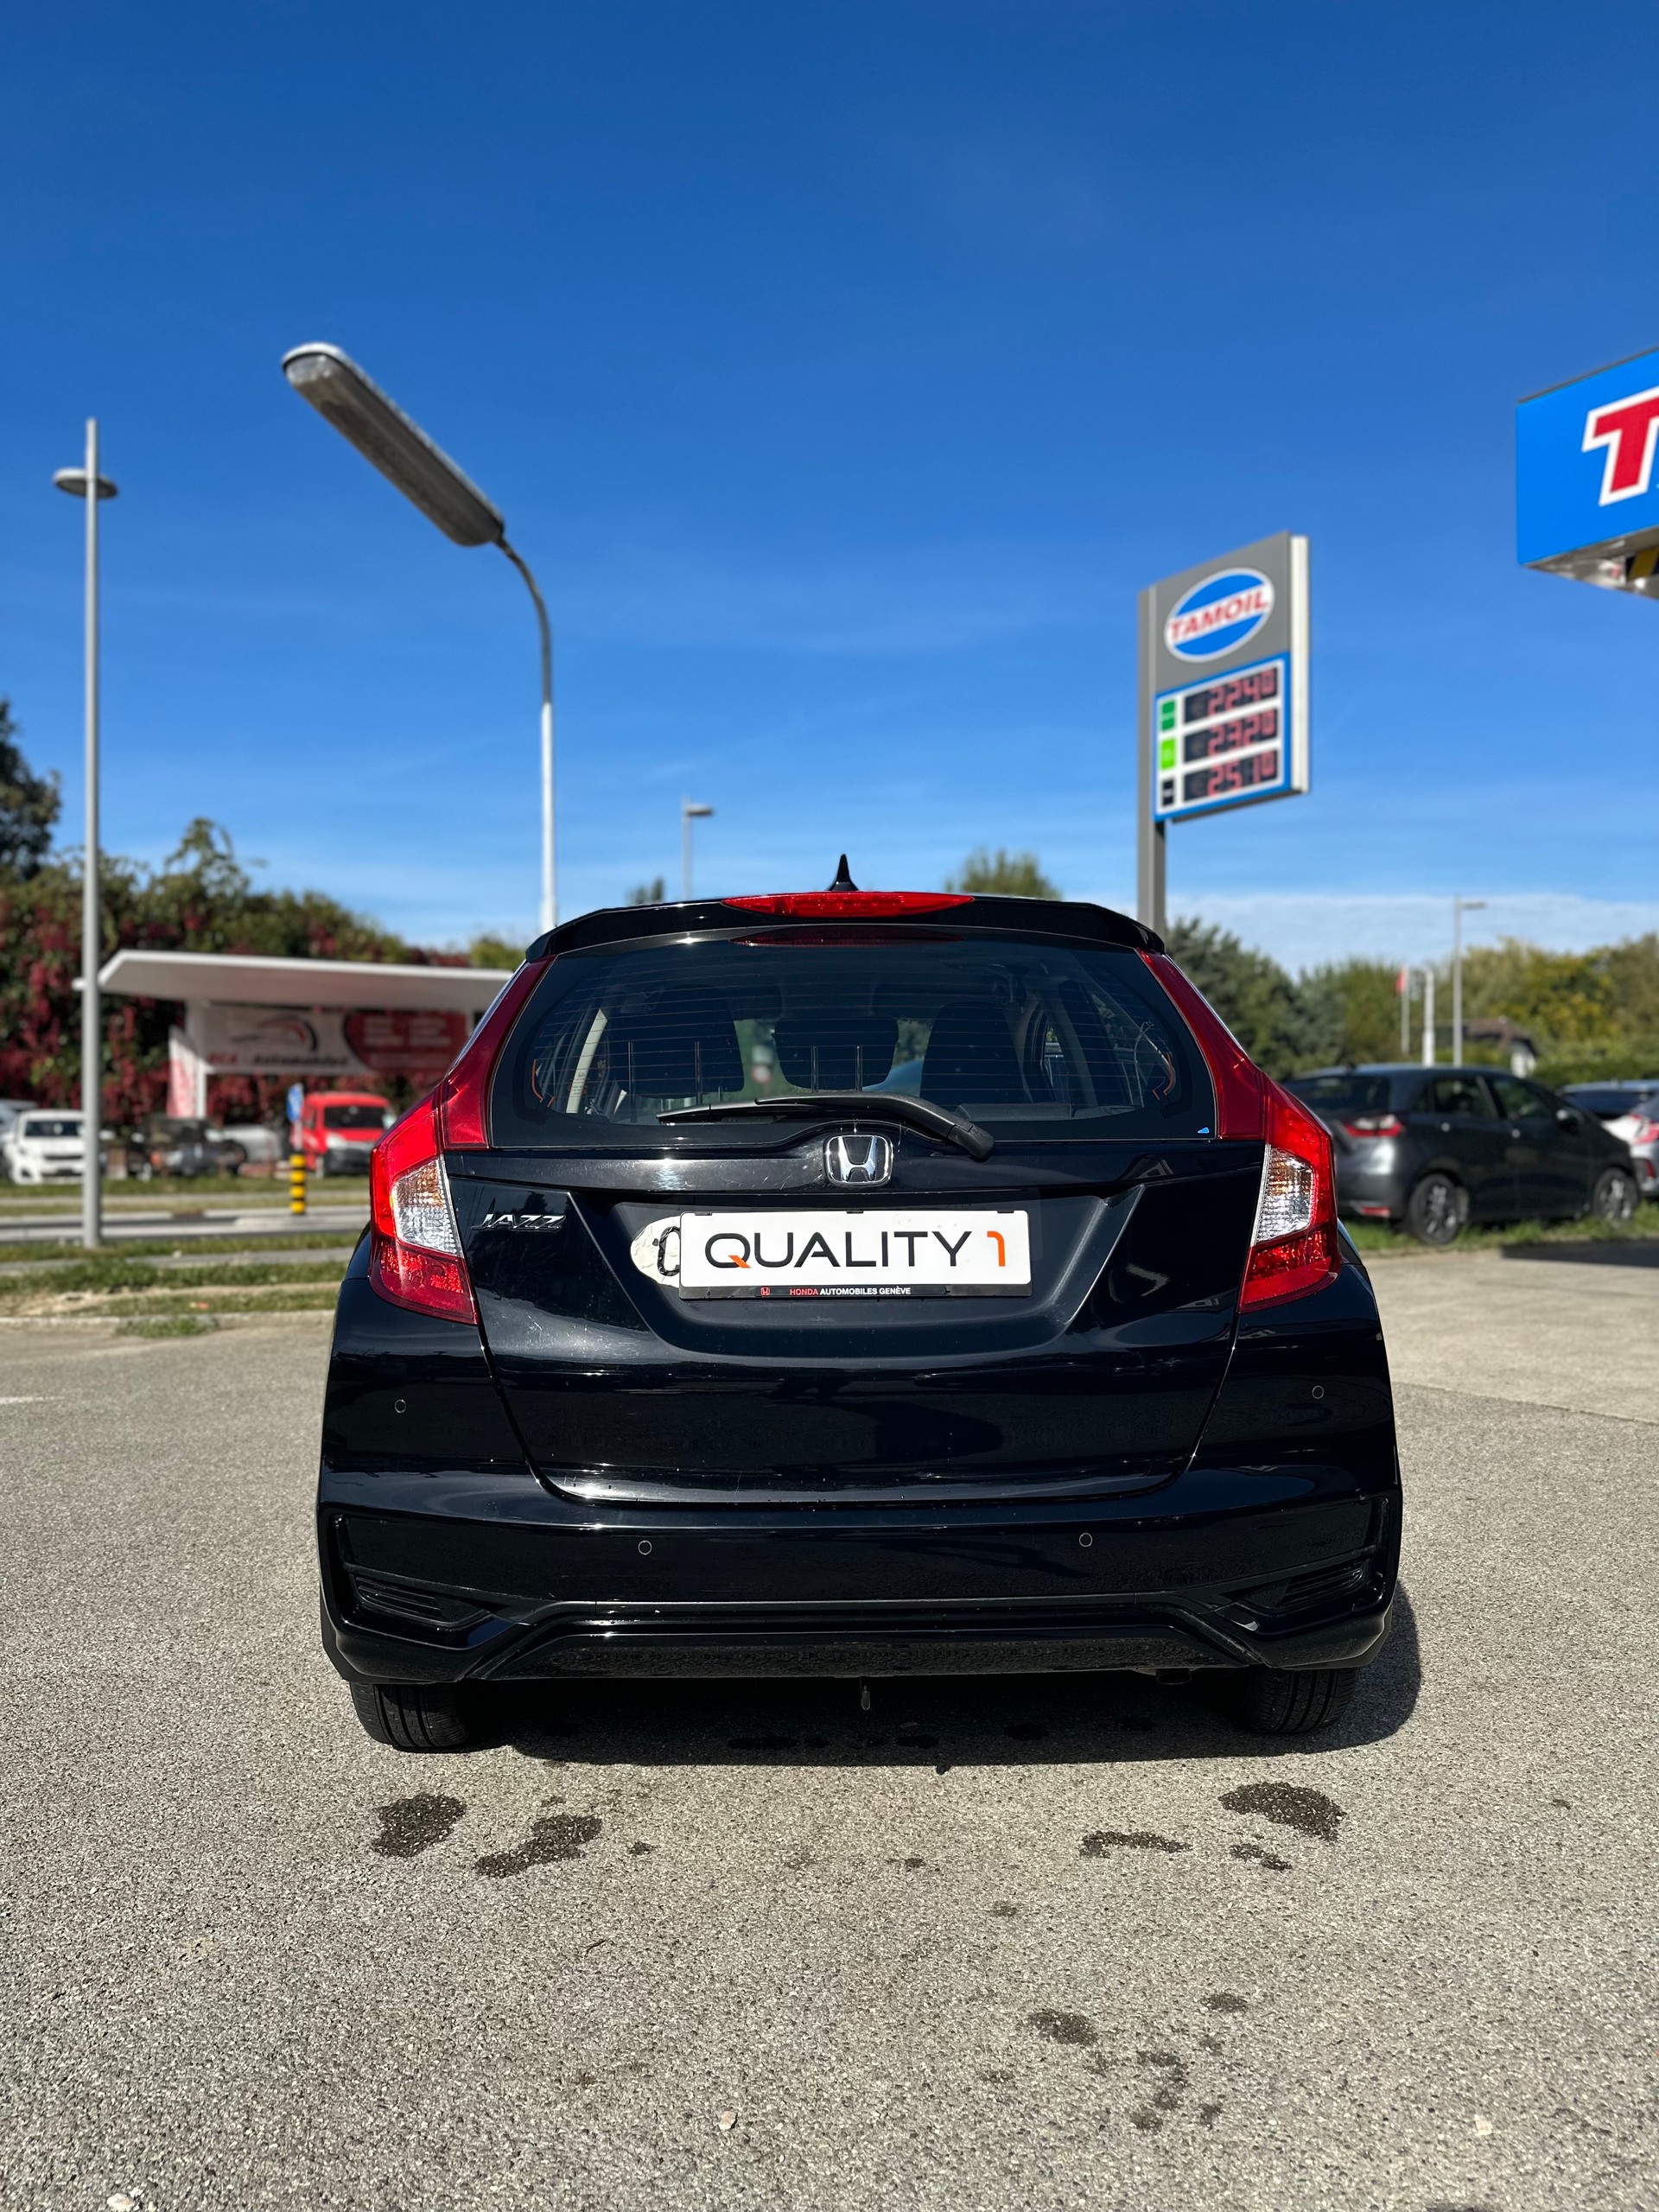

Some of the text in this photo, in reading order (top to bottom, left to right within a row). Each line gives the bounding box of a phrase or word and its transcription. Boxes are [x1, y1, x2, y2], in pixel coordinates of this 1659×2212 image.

[1582, 386, 1659, 507] T
[1169, 589, 1268, 641] TAMOIL
[470, 1213, 566, 1232] JAZZ
[704, 1230, 1007, 1269] QUALITY 1
[820, 1287, 878, 1295] AUTOMOBILES
[879, 1285, 912, 1294] GENÈVE
